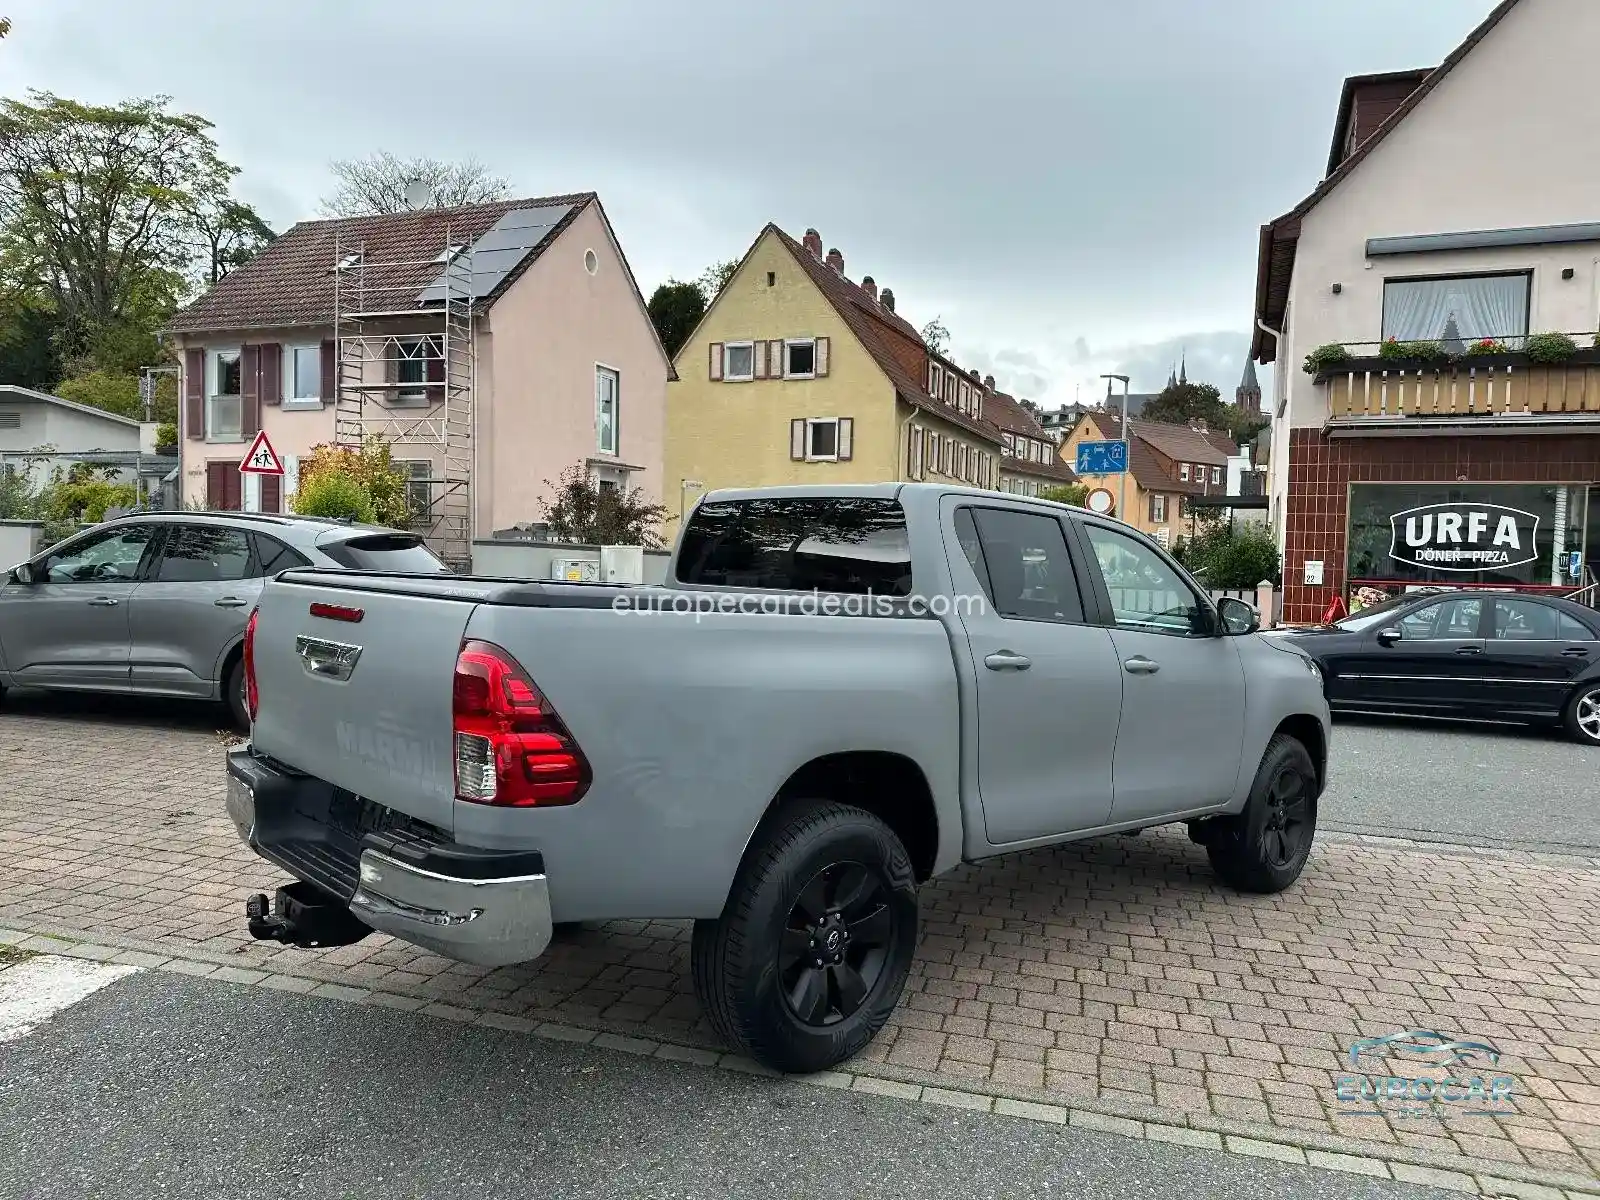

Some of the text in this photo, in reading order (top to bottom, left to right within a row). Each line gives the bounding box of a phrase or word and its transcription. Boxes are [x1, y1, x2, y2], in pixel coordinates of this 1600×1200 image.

[1405, 511, 1521, 550] URFA
[1415, 547, 1509, 563] DÖNER PIZZA
[1306, 574, 1315, 584] 22
